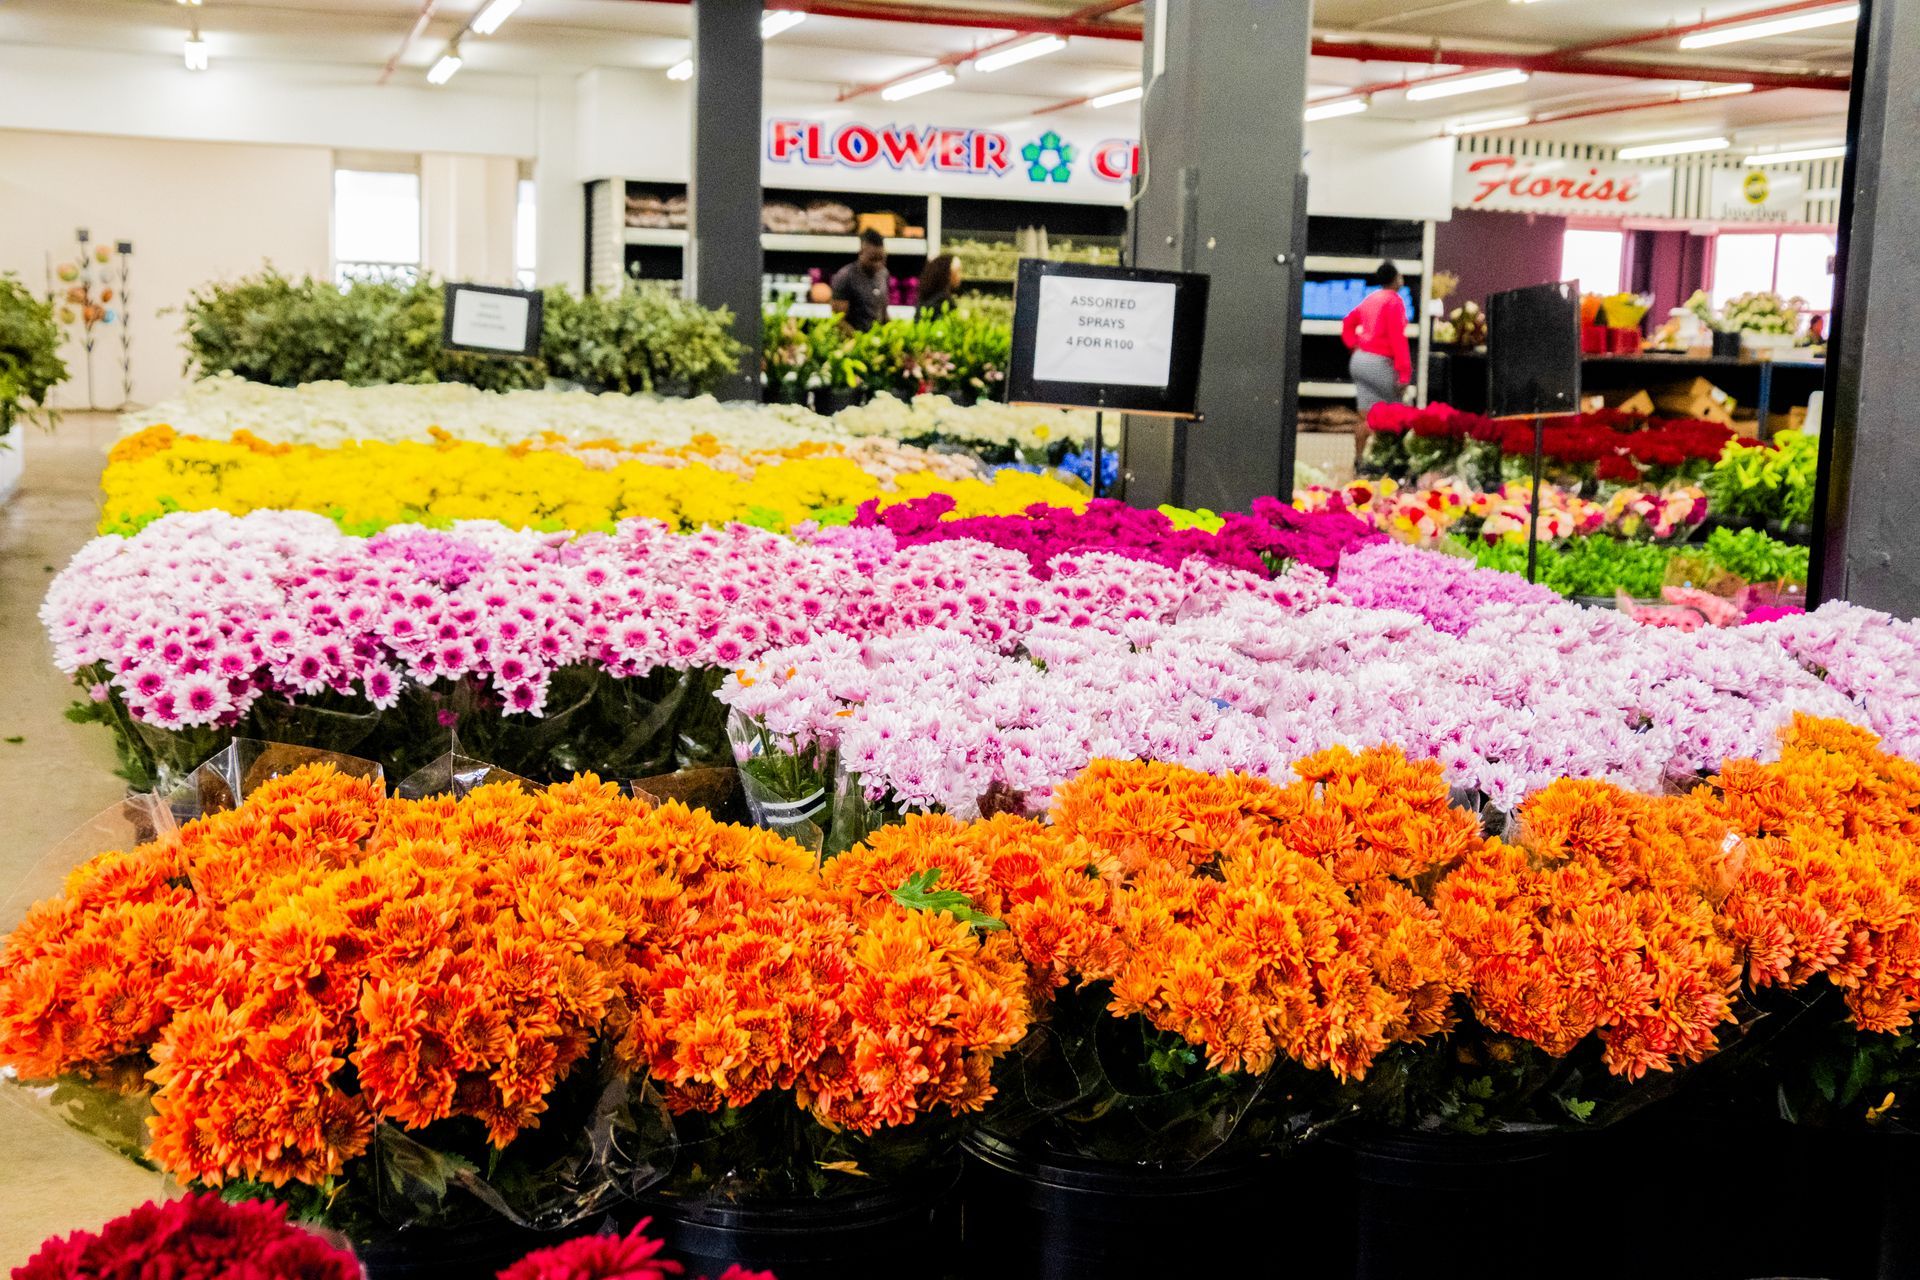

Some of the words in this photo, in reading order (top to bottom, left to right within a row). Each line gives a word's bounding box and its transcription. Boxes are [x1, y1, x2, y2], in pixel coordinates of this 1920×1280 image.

[769, 118, 1014, 177] FLOWER
[1468, 156, 1640, 203] Florist
[1070, 295, 1137, 310] ASSORTED
[1078, 315, 1126, 330] SPRAYS
[1066, 335, 1074, 347] 4
[1076, 336, 1101, 348] FOR
[1104, 337, 1134, 350] R100
